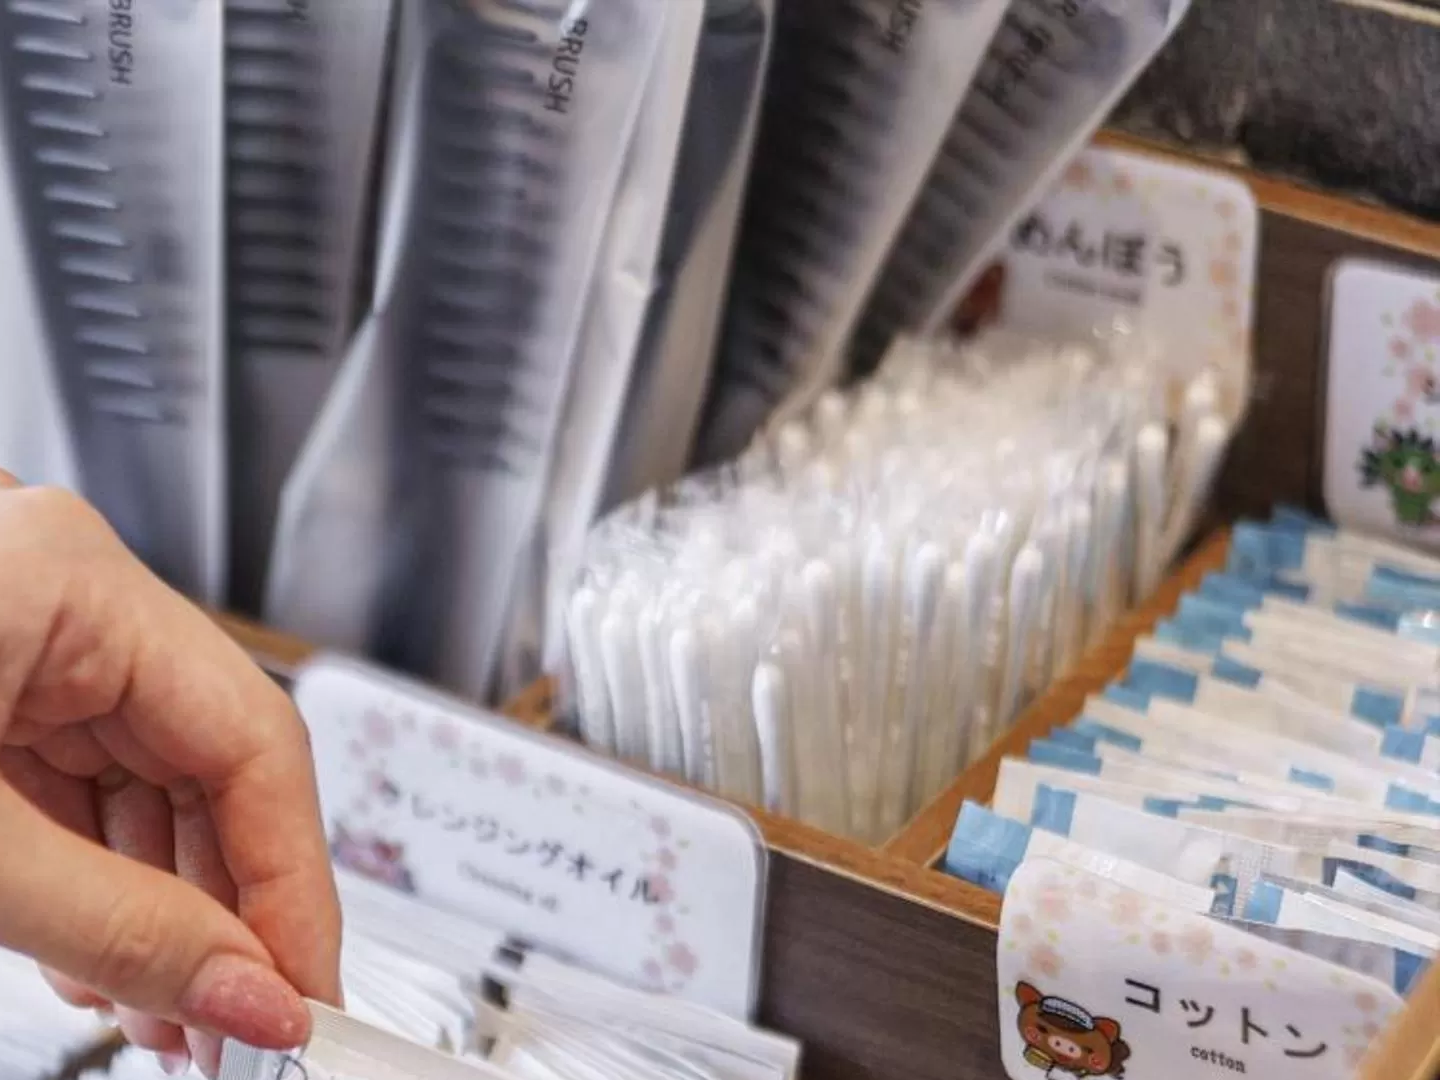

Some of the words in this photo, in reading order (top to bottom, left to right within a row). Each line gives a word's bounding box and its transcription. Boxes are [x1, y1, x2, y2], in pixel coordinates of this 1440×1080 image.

[1124, 977, 1329, 1060] コットン
[1189, 1043, 1248, 1075] cotton
